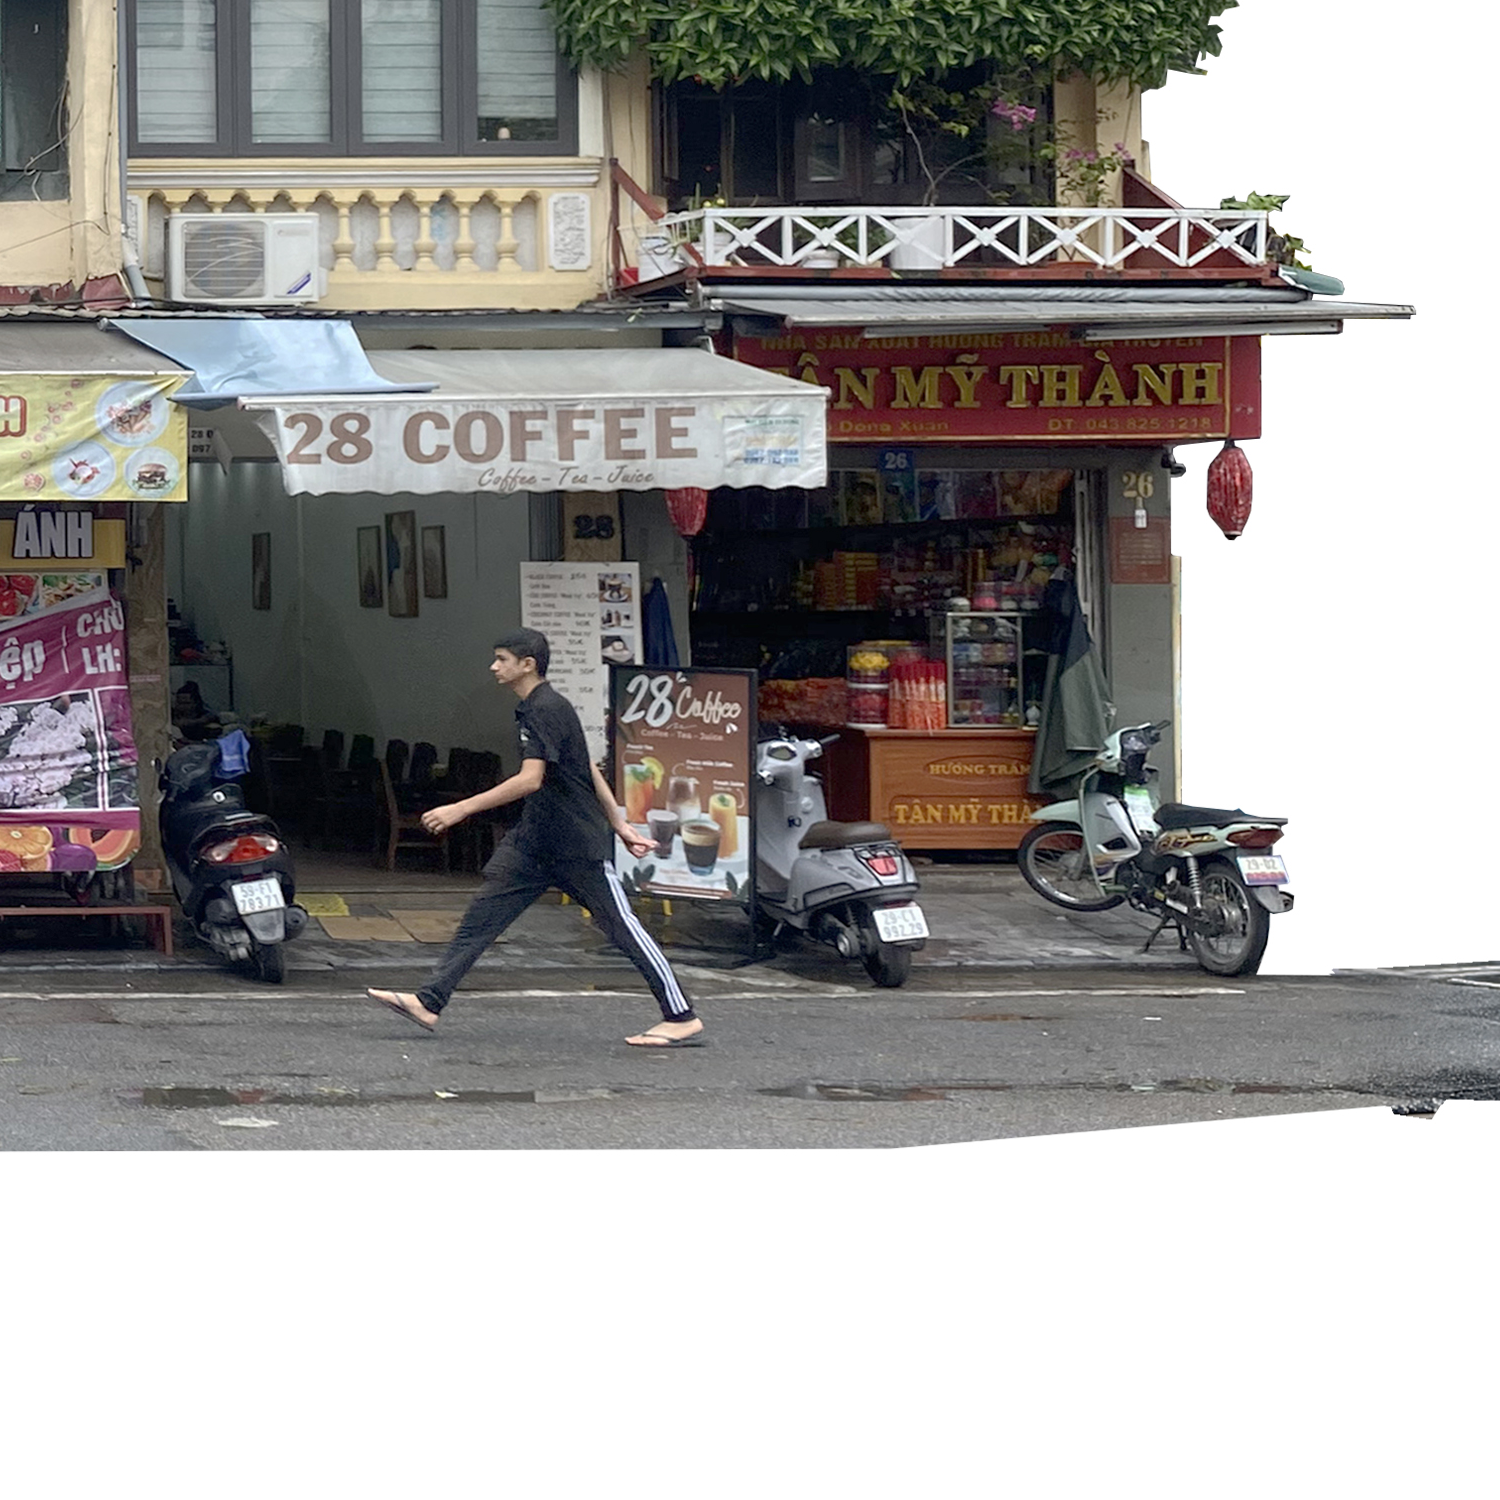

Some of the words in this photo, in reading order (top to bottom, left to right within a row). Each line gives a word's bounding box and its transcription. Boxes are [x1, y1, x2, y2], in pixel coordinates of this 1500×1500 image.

[766, 352, 881, 410] ÂN
[890, 352, 990, 409] MỸ
[1000, 349, 1223, 408] THÀNH
[284, 411, 374, 465] 28
[402, 405, 698, 465] COFFEE
[884, 451, 908, 470] 26
[478, 466, 537, 492] Coffee
[558, 466, 588, 486] Tea
[606, 464, 654, 485] Juice
[1122, 470, 1154, 498] 26
[12, 503, 95, 560] ÁNH
[574, 514, 615, 539] 28
[81, 642, 122, 675] LH:
[621, 674, 674, 728] 28
[675, 685, 742, 724] Coffee
[640, 729, 669, 738] Coffee
[894, 799, 944, 825] TÂN
[948, 797, 983, 825] MỸ
[987, 799, 1046, 826] THÀ
